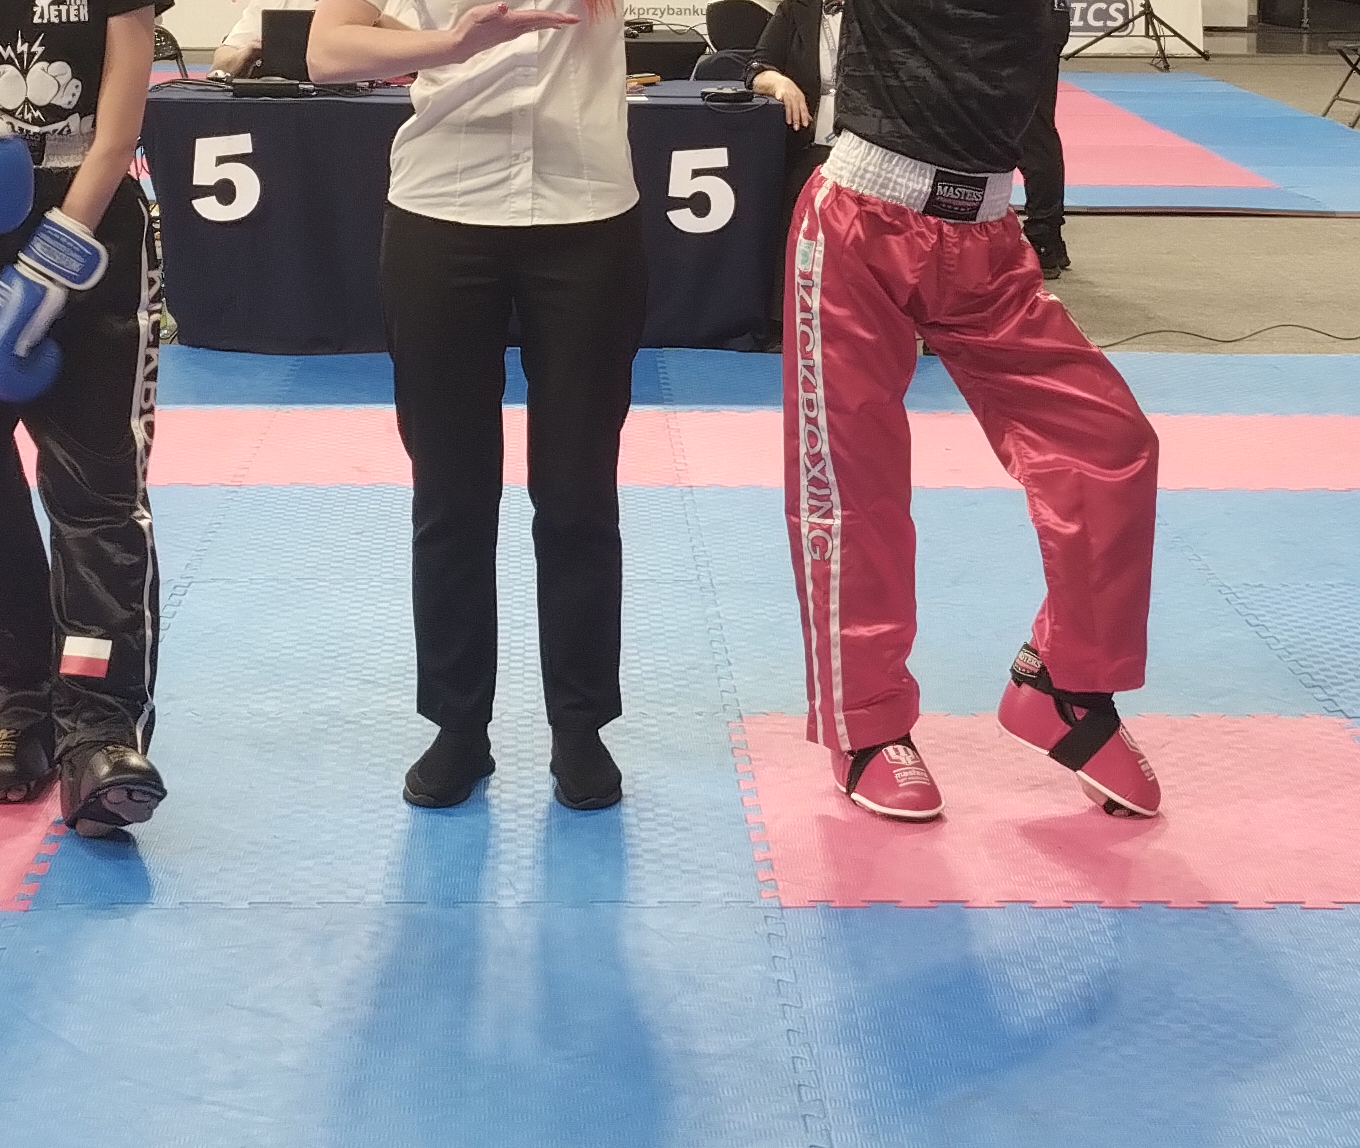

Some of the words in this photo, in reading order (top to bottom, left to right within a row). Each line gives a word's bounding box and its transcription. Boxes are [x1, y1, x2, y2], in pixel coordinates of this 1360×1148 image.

[1069, 2, 1127, 27] ICS
[190, 132, 261, 222] 5
[665, 146, 736, 234] 5
[796, 274, 836, 562] KICKBOXING
